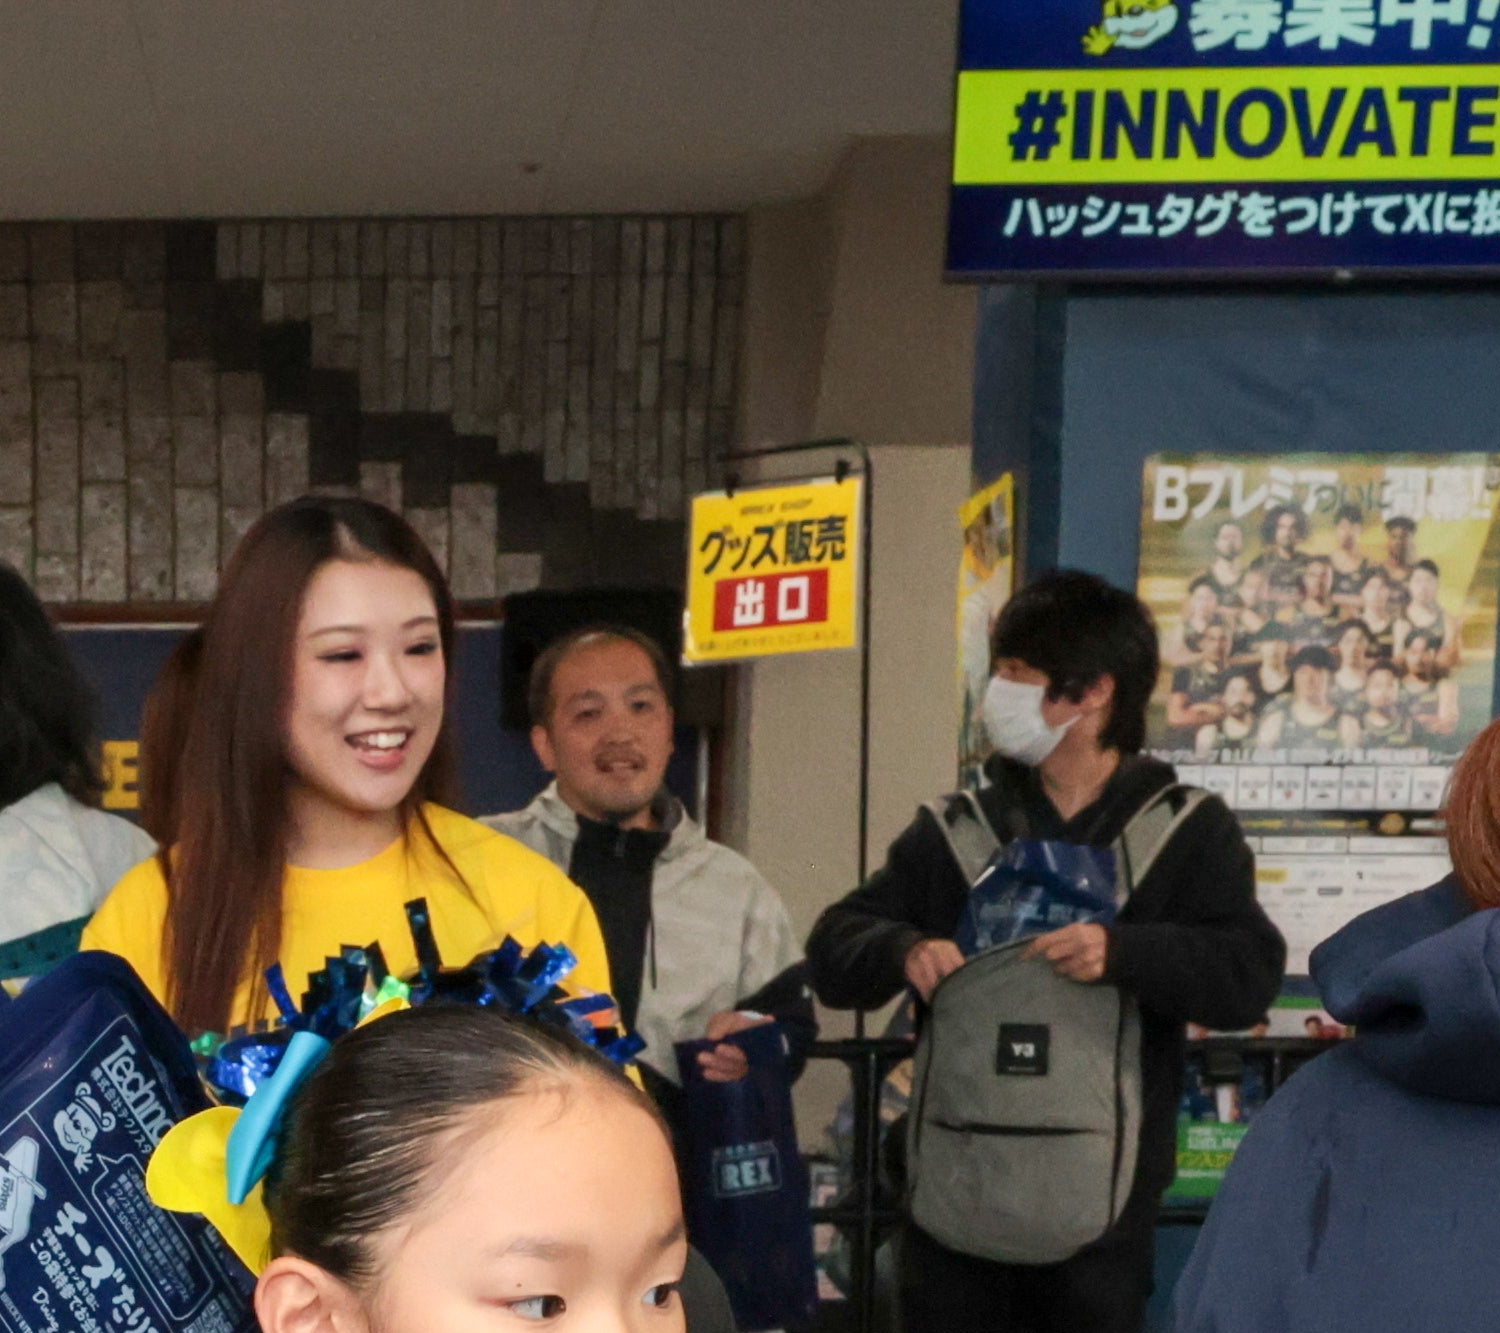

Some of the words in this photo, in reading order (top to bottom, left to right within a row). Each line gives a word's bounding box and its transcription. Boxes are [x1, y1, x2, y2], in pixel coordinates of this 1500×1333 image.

[700, 514, 848, 575] グッズ販売
[733, 575, 810, 627] 出口
